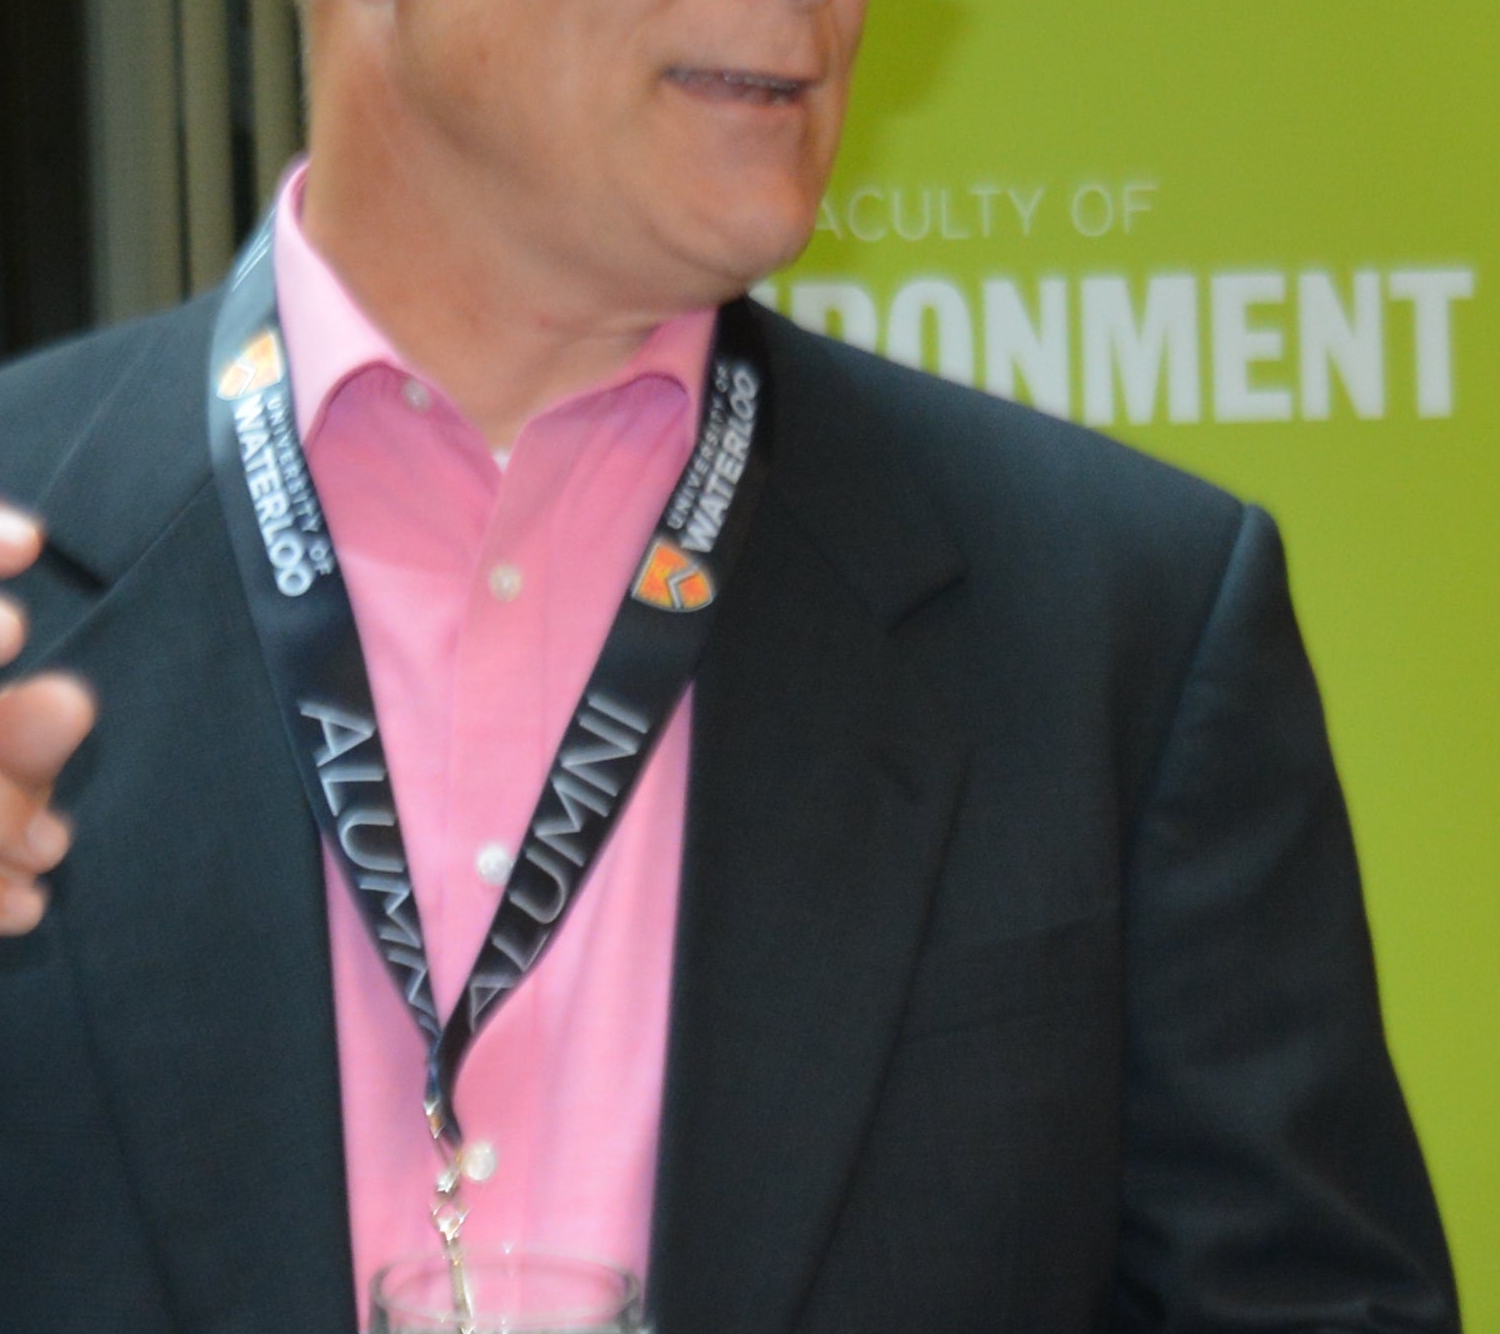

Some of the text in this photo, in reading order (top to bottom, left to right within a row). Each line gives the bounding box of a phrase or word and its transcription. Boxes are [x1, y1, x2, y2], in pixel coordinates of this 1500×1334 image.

[814, 181, 1161, 243] ACULTY OF
[748, 265, 1477, 428] ONMENT
[234, 394, 315, 597] WATERLOO
[266, 392, 335, 576] UNIVERSITY OF
[667, 396, 726, 530] UNIVERSITY
[680, 367, 760, 554] WATERLOO
[469, 690, 655, 1034] ALUMNI
